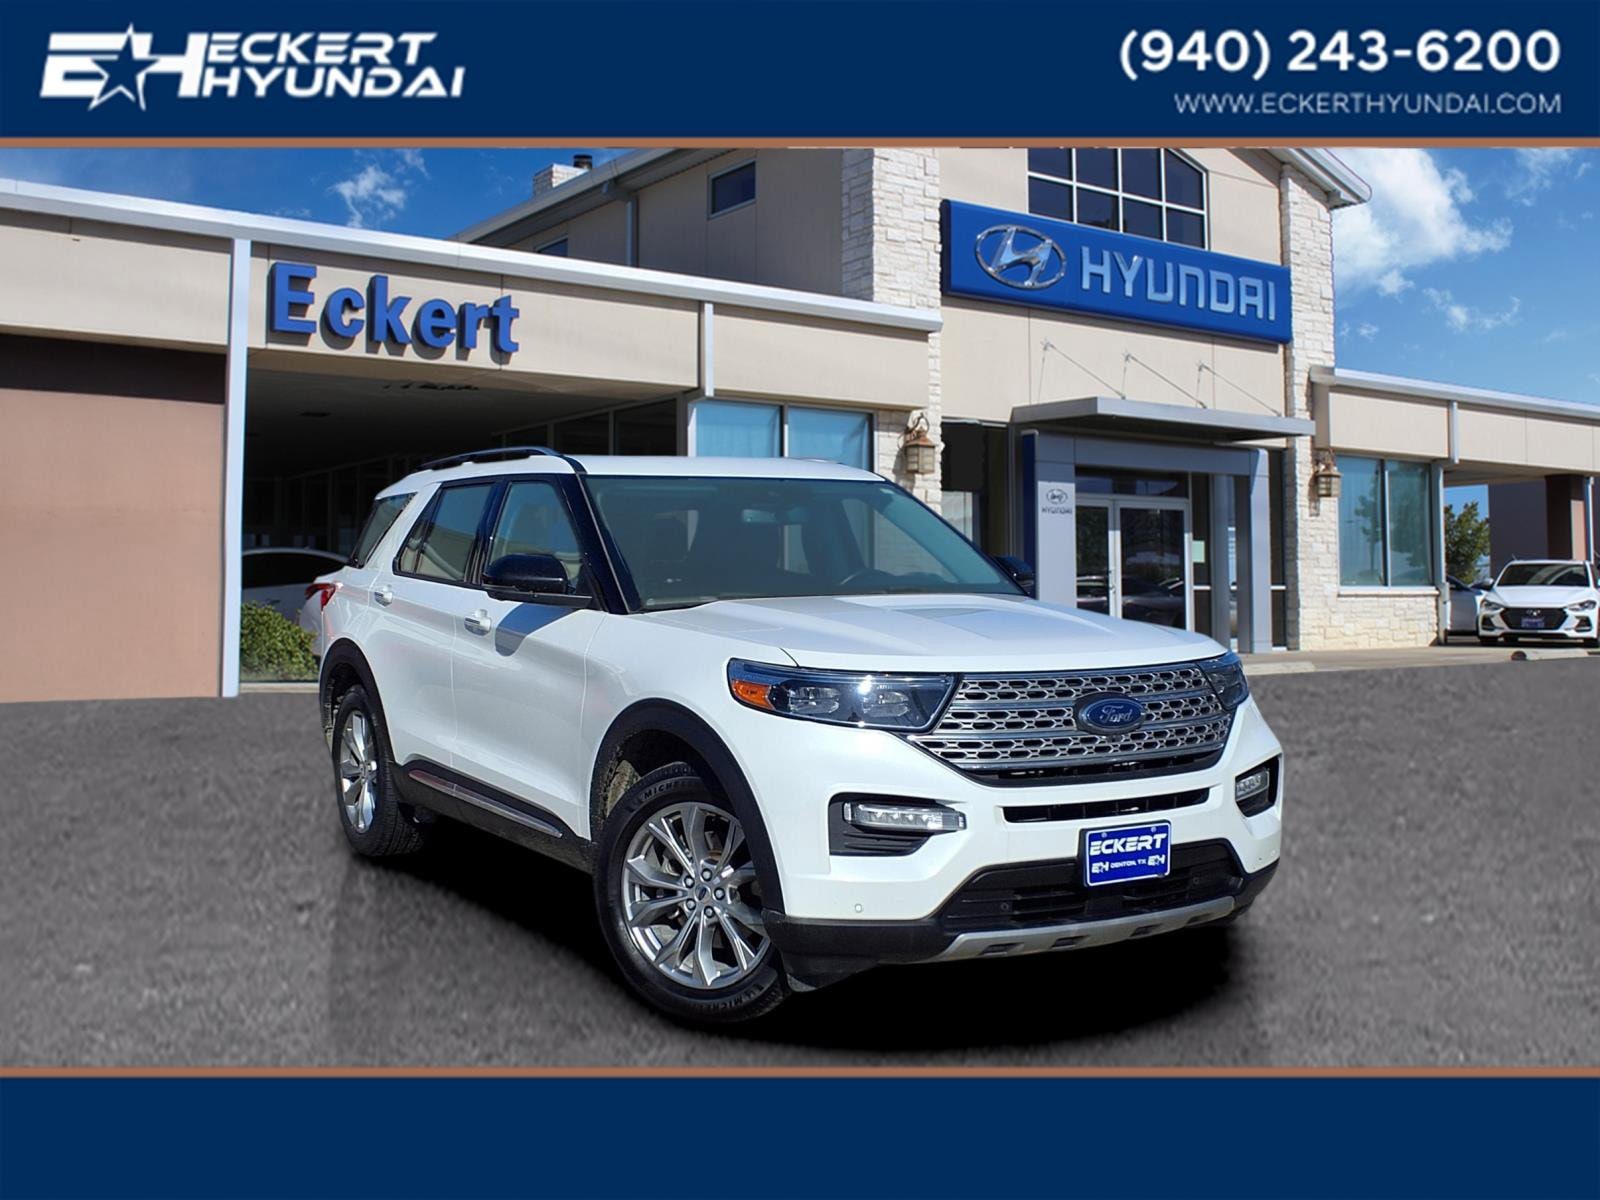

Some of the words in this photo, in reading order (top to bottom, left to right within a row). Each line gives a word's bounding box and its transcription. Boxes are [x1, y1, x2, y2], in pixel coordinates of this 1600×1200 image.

[1080, 245, 1277, 321] HYUNDAI
[269, 262, 520, 354] Eckert
[1099, 704, 1134, 723] Ford
[1090, 833, 1167, 856] ECKERT
